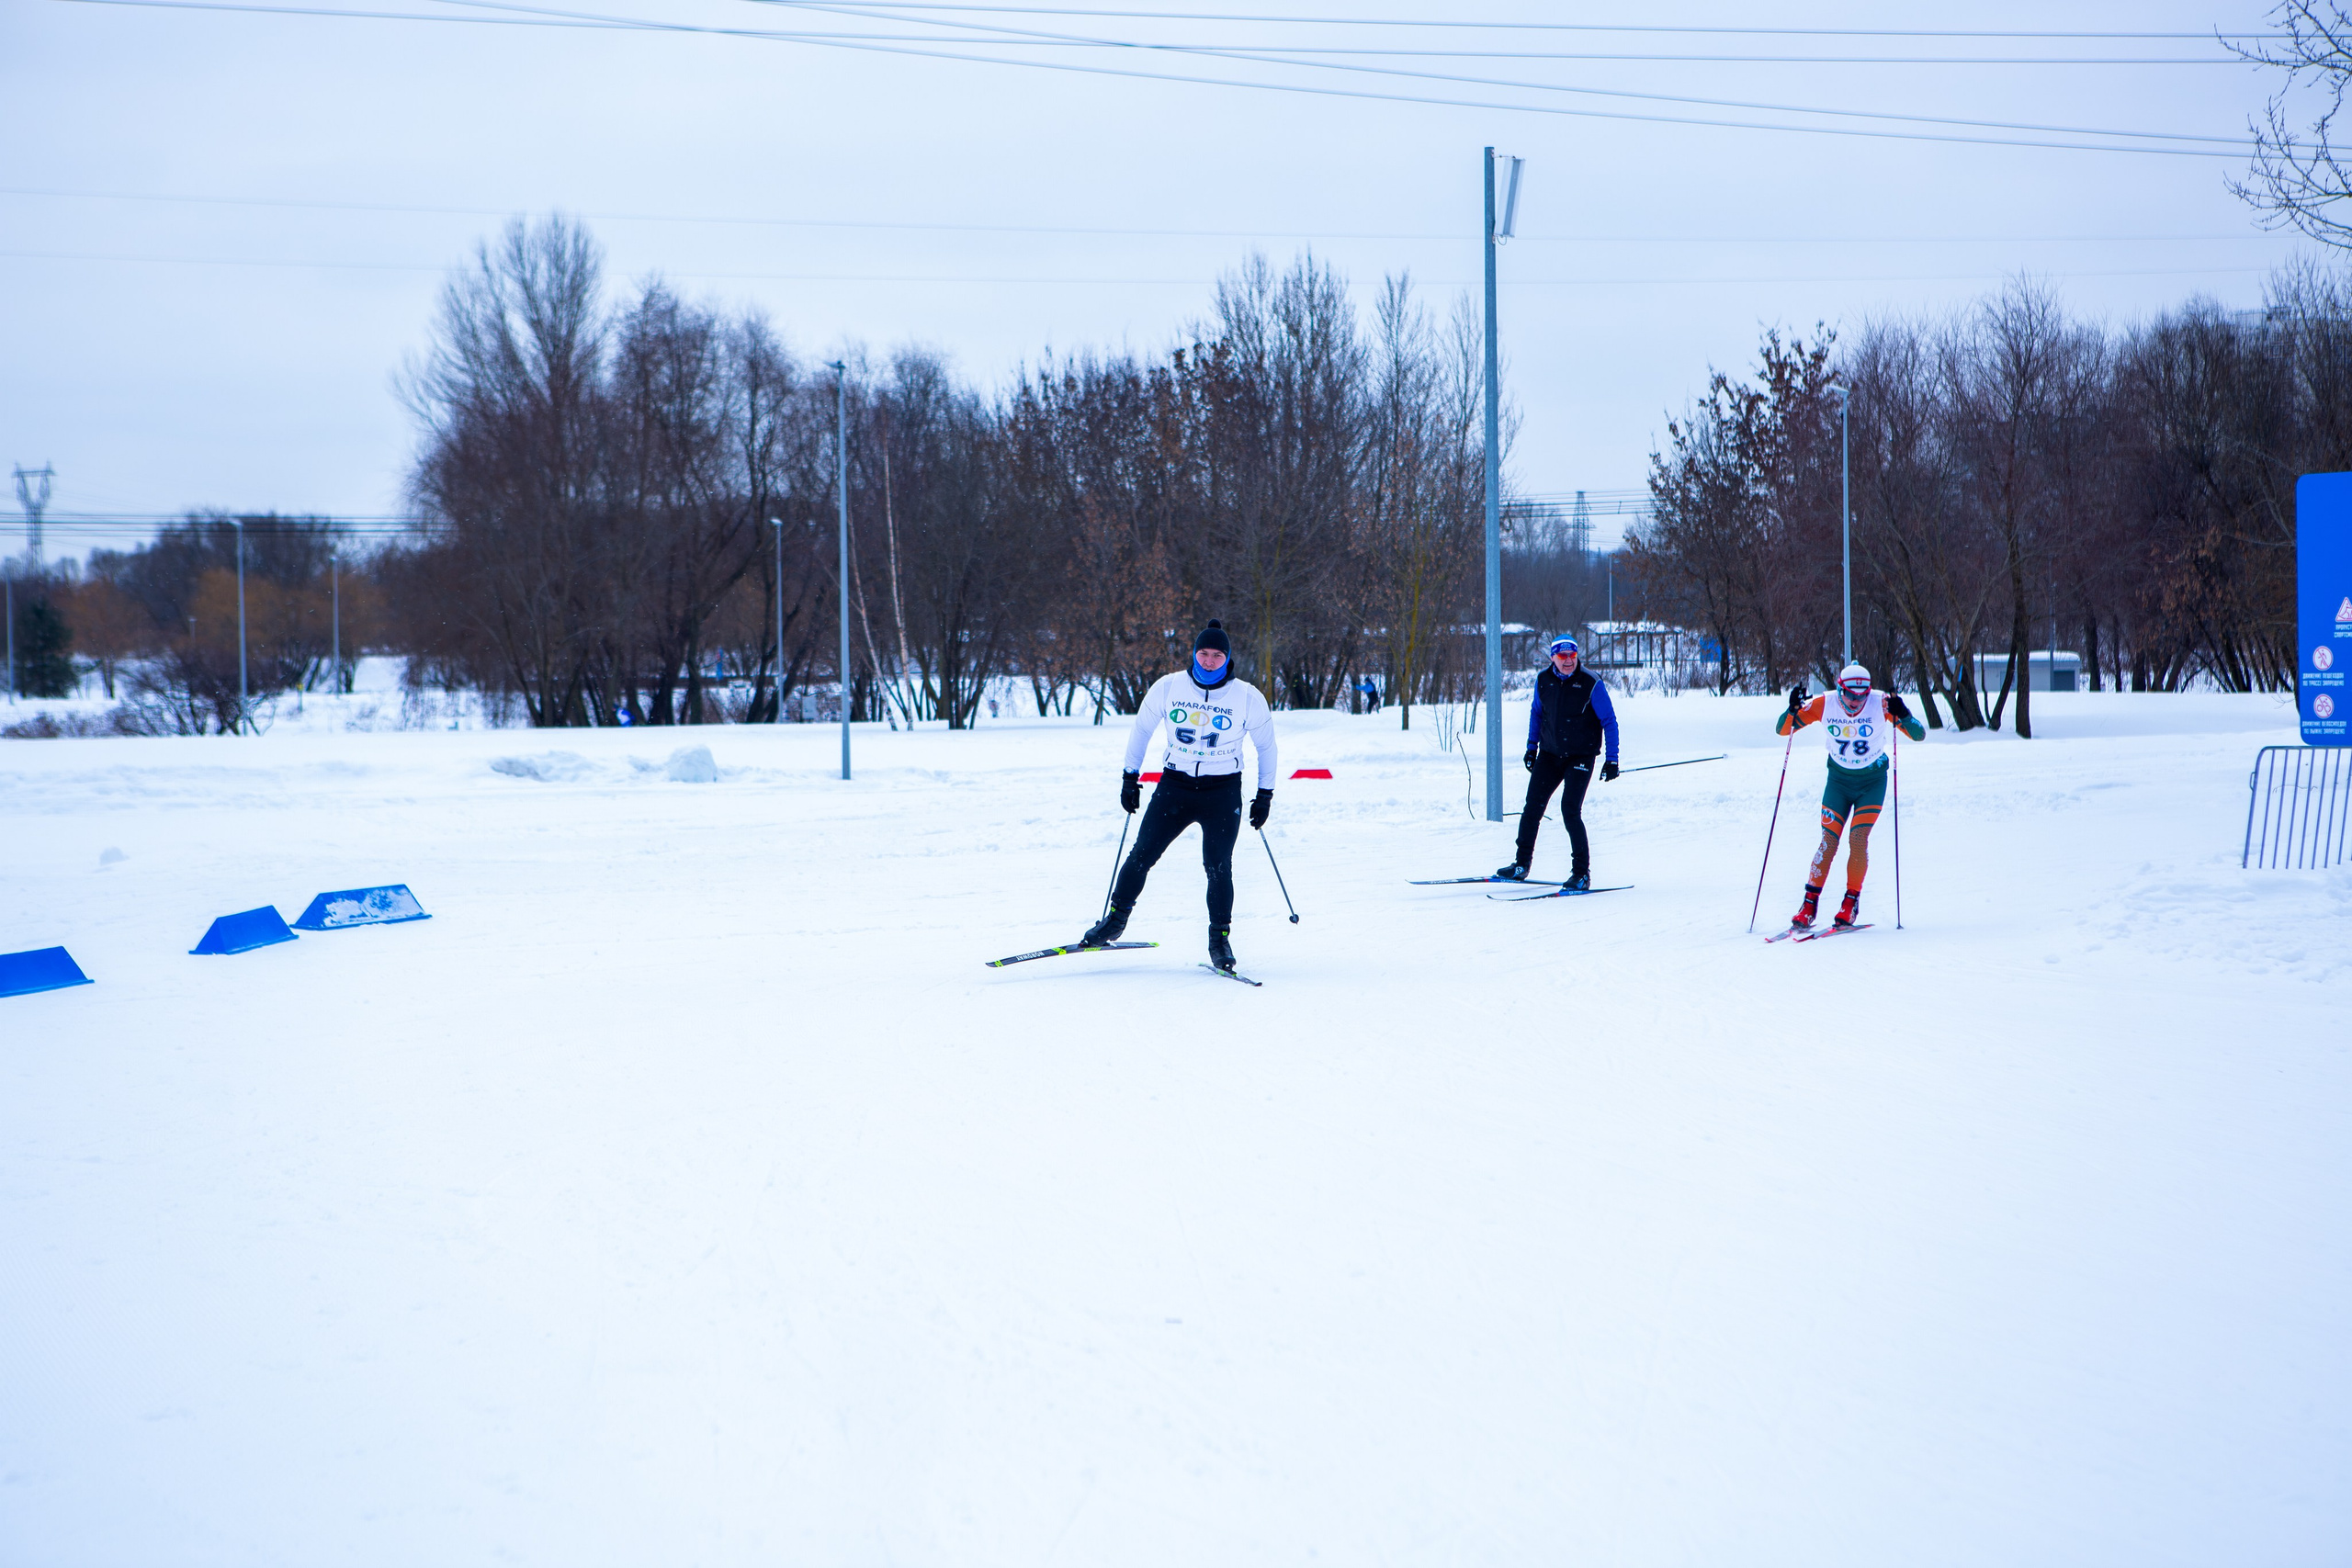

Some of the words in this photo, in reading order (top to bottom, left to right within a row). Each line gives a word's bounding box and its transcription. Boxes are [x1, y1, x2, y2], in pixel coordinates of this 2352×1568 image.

[1171, 701, 1233, 716] VMARAFONE
[1175, 727, 1220, 748] 51
[1834, 739, 1871, 756] 78
